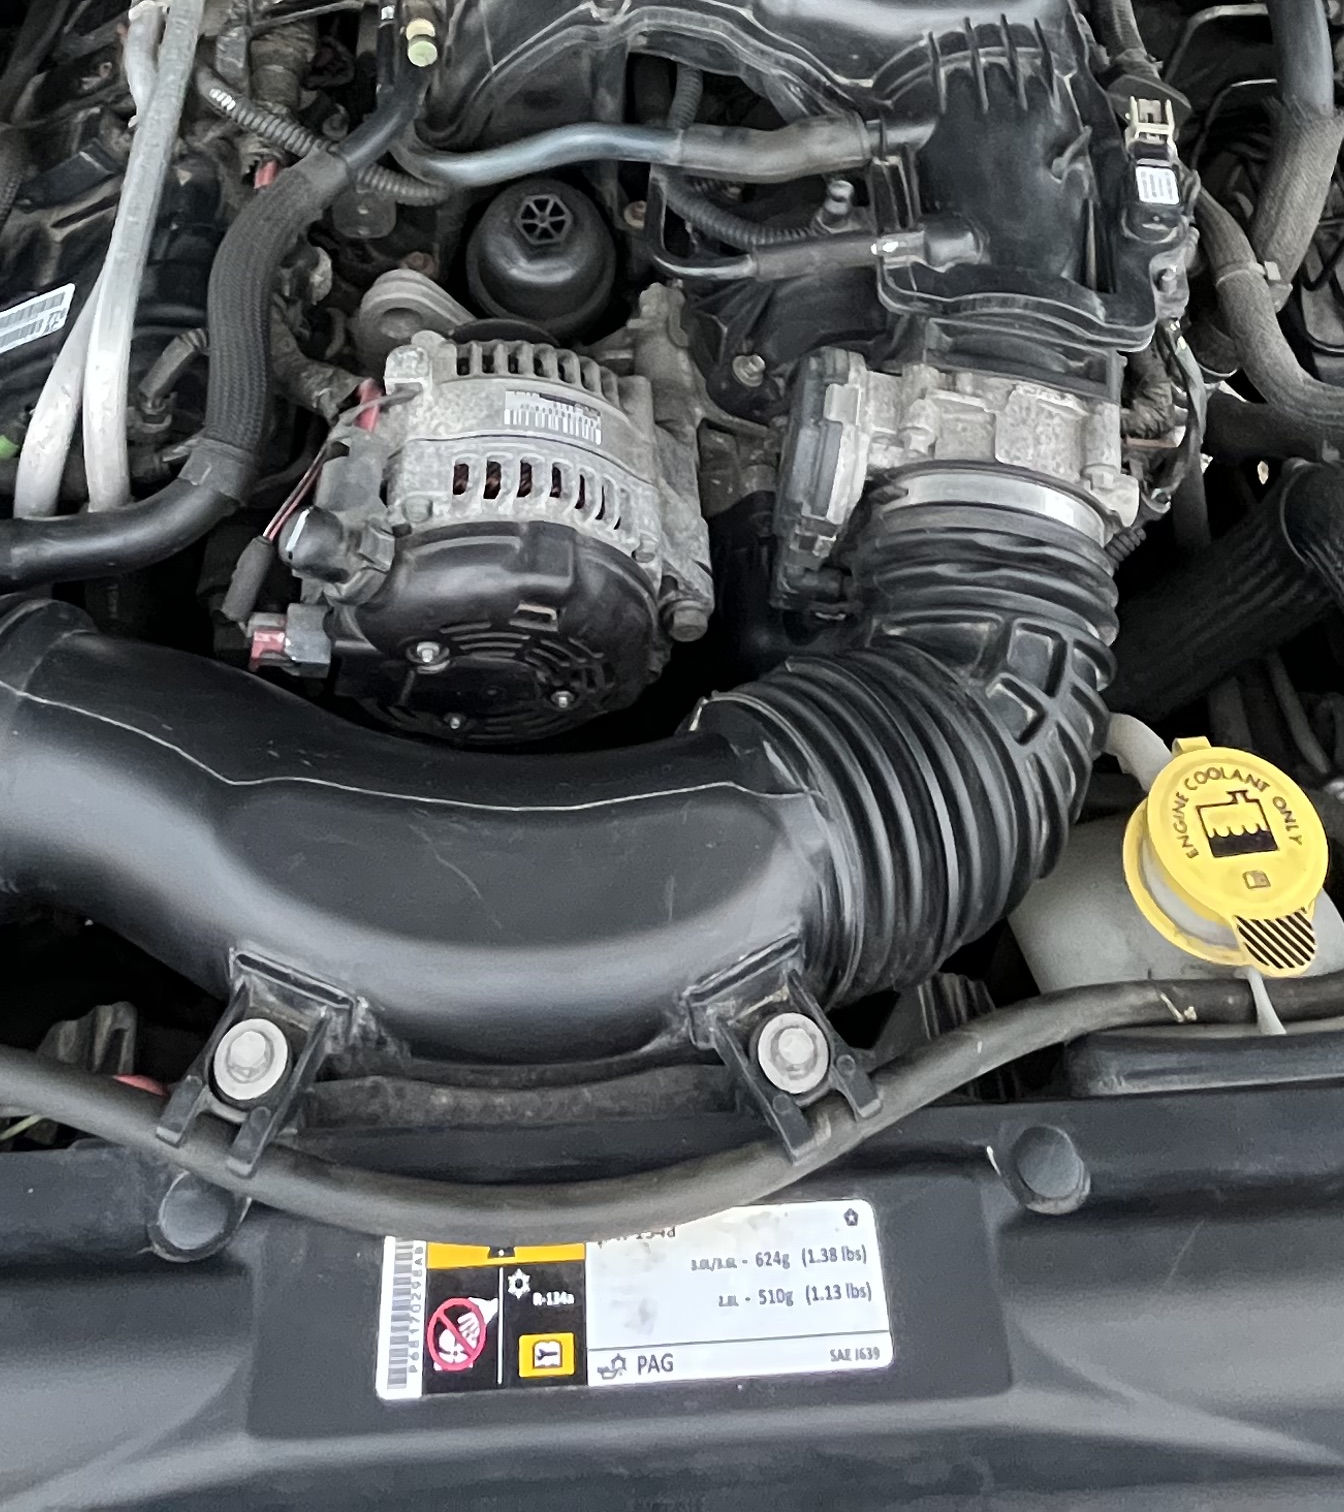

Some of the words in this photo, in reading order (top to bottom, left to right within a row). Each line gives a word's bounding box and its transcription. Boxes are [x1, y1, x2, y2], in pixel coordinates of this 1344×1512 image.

[1184, 766, 1271, 793] COOLANT
[1171, 791, 1200, 859] ENGINE
[1272, 795, 1303, 846] ONLY
[755, 1249, 791, 1272] 624g
[801, 1246, 837, 1269] (1.38
[840, 1243, 869, 1266] lbs)
[758, 1288, 794, 1310] 510g
[805, 1283, 841, 1306] (1.13
[844, 1280, 873, 1303] lbs)
[636, 1352, 675, 1376] PAG
[829, 1348, 853, 1363] SAE
